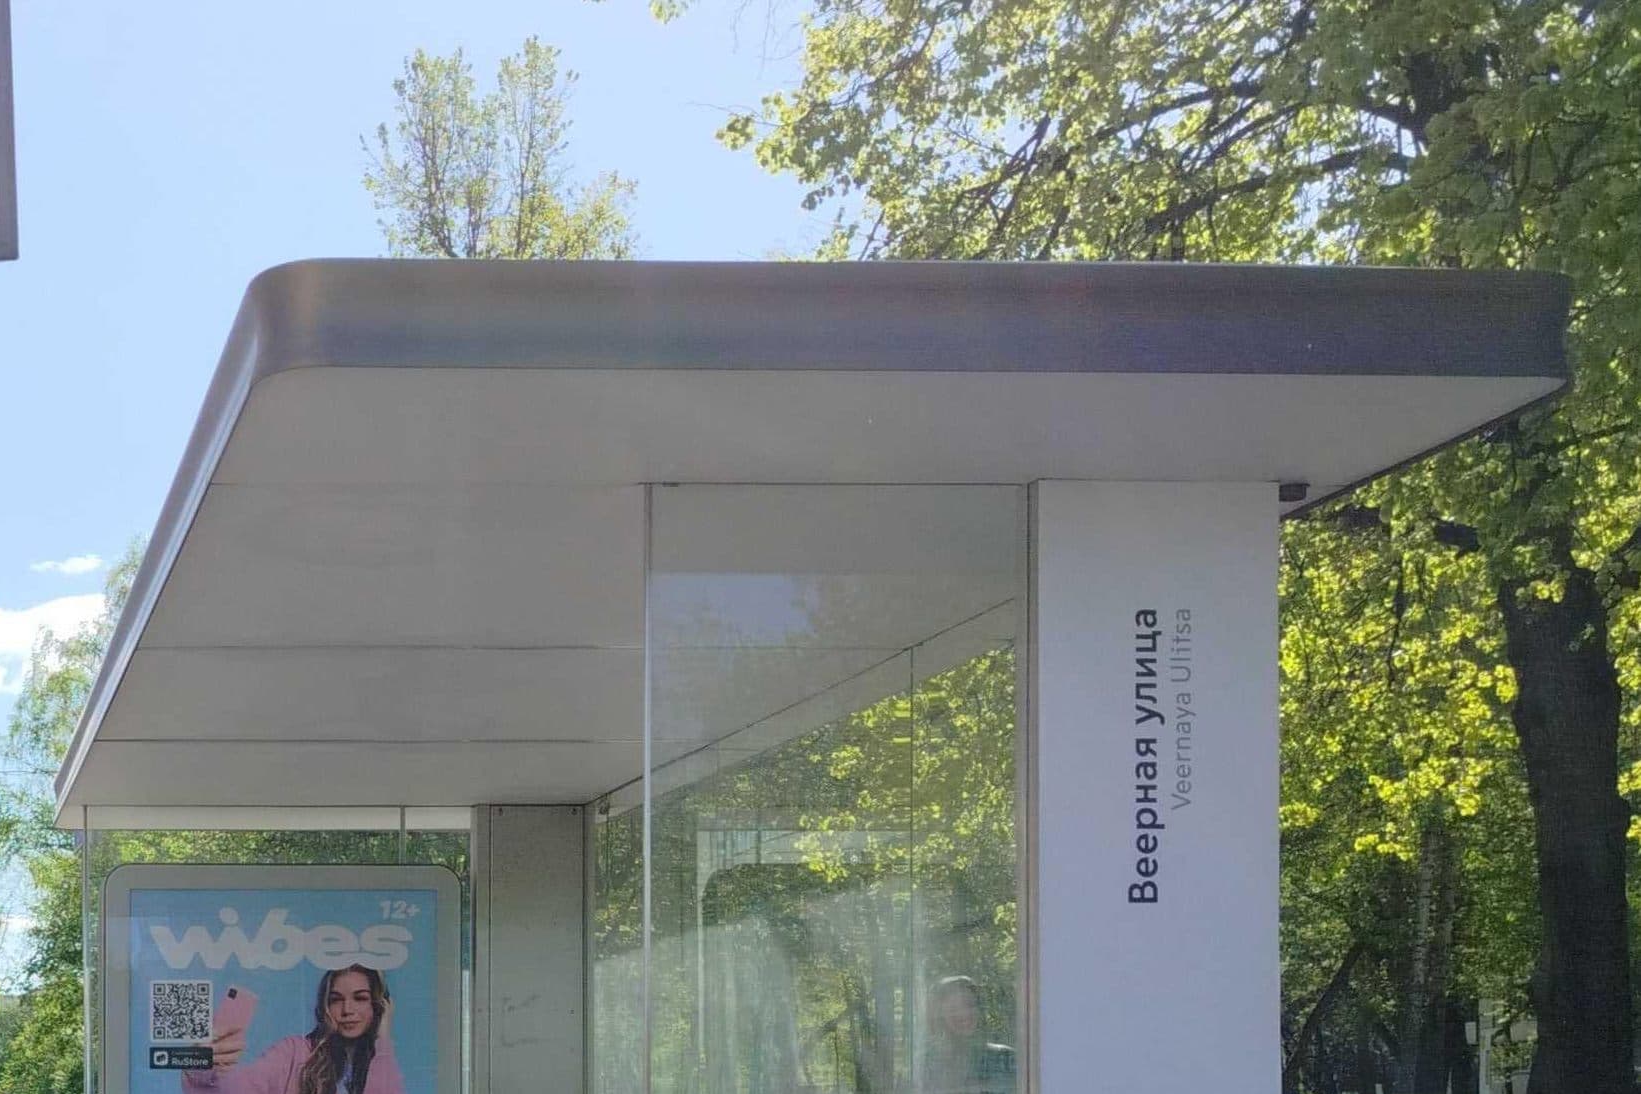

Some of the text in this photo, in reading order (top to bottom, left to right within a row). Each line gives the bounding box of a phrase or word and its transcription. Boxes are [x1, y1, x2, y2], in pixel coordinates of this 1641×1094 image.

[1170, 609, 1196, 810] Veernaya Ulitsa
[1128, 609, 1165, 903] Веерная улица
[150, 906, 413, 970] wibes
[380, 900, 421, 920] 12+
[171, 1057, 209, 1066] RuStore
